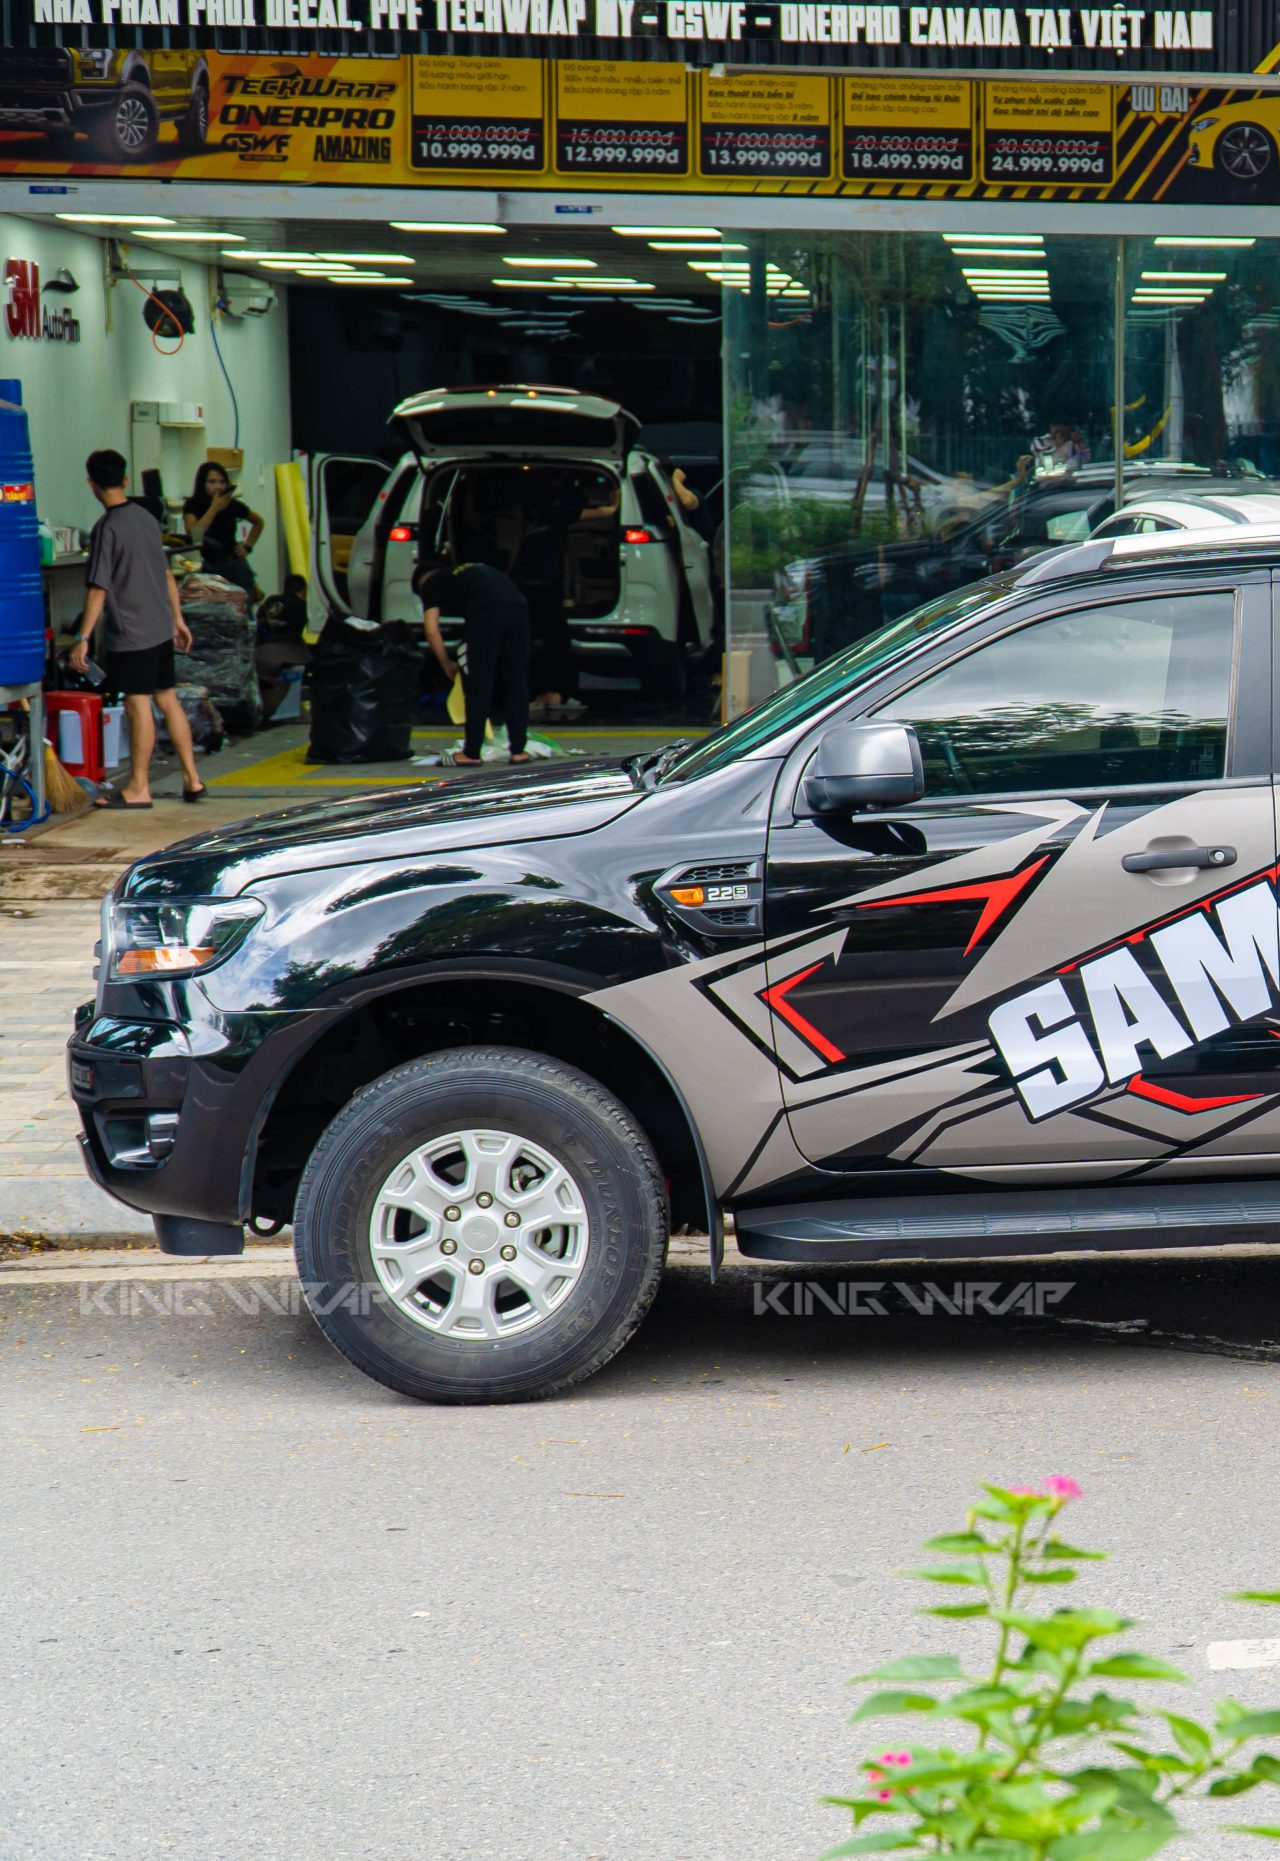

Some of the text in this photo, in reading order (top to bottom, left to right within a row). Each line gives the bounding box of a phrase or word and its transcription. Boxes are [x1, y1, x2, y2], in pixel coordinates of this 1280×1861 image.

[667, 1, 746, 40] GSWF
[910, 7, 1020, 46] CANADA
[1025, 8, 1072, 53] TẠI
[1080, 3, 1145, 56] VIỆT
[1154, 10, 1213, 49] NAM
[220, 104, 395, 130] ONERPRO
[313, 135, 391, 163] AMAZING
[6, 258, 40, 337] 3M
